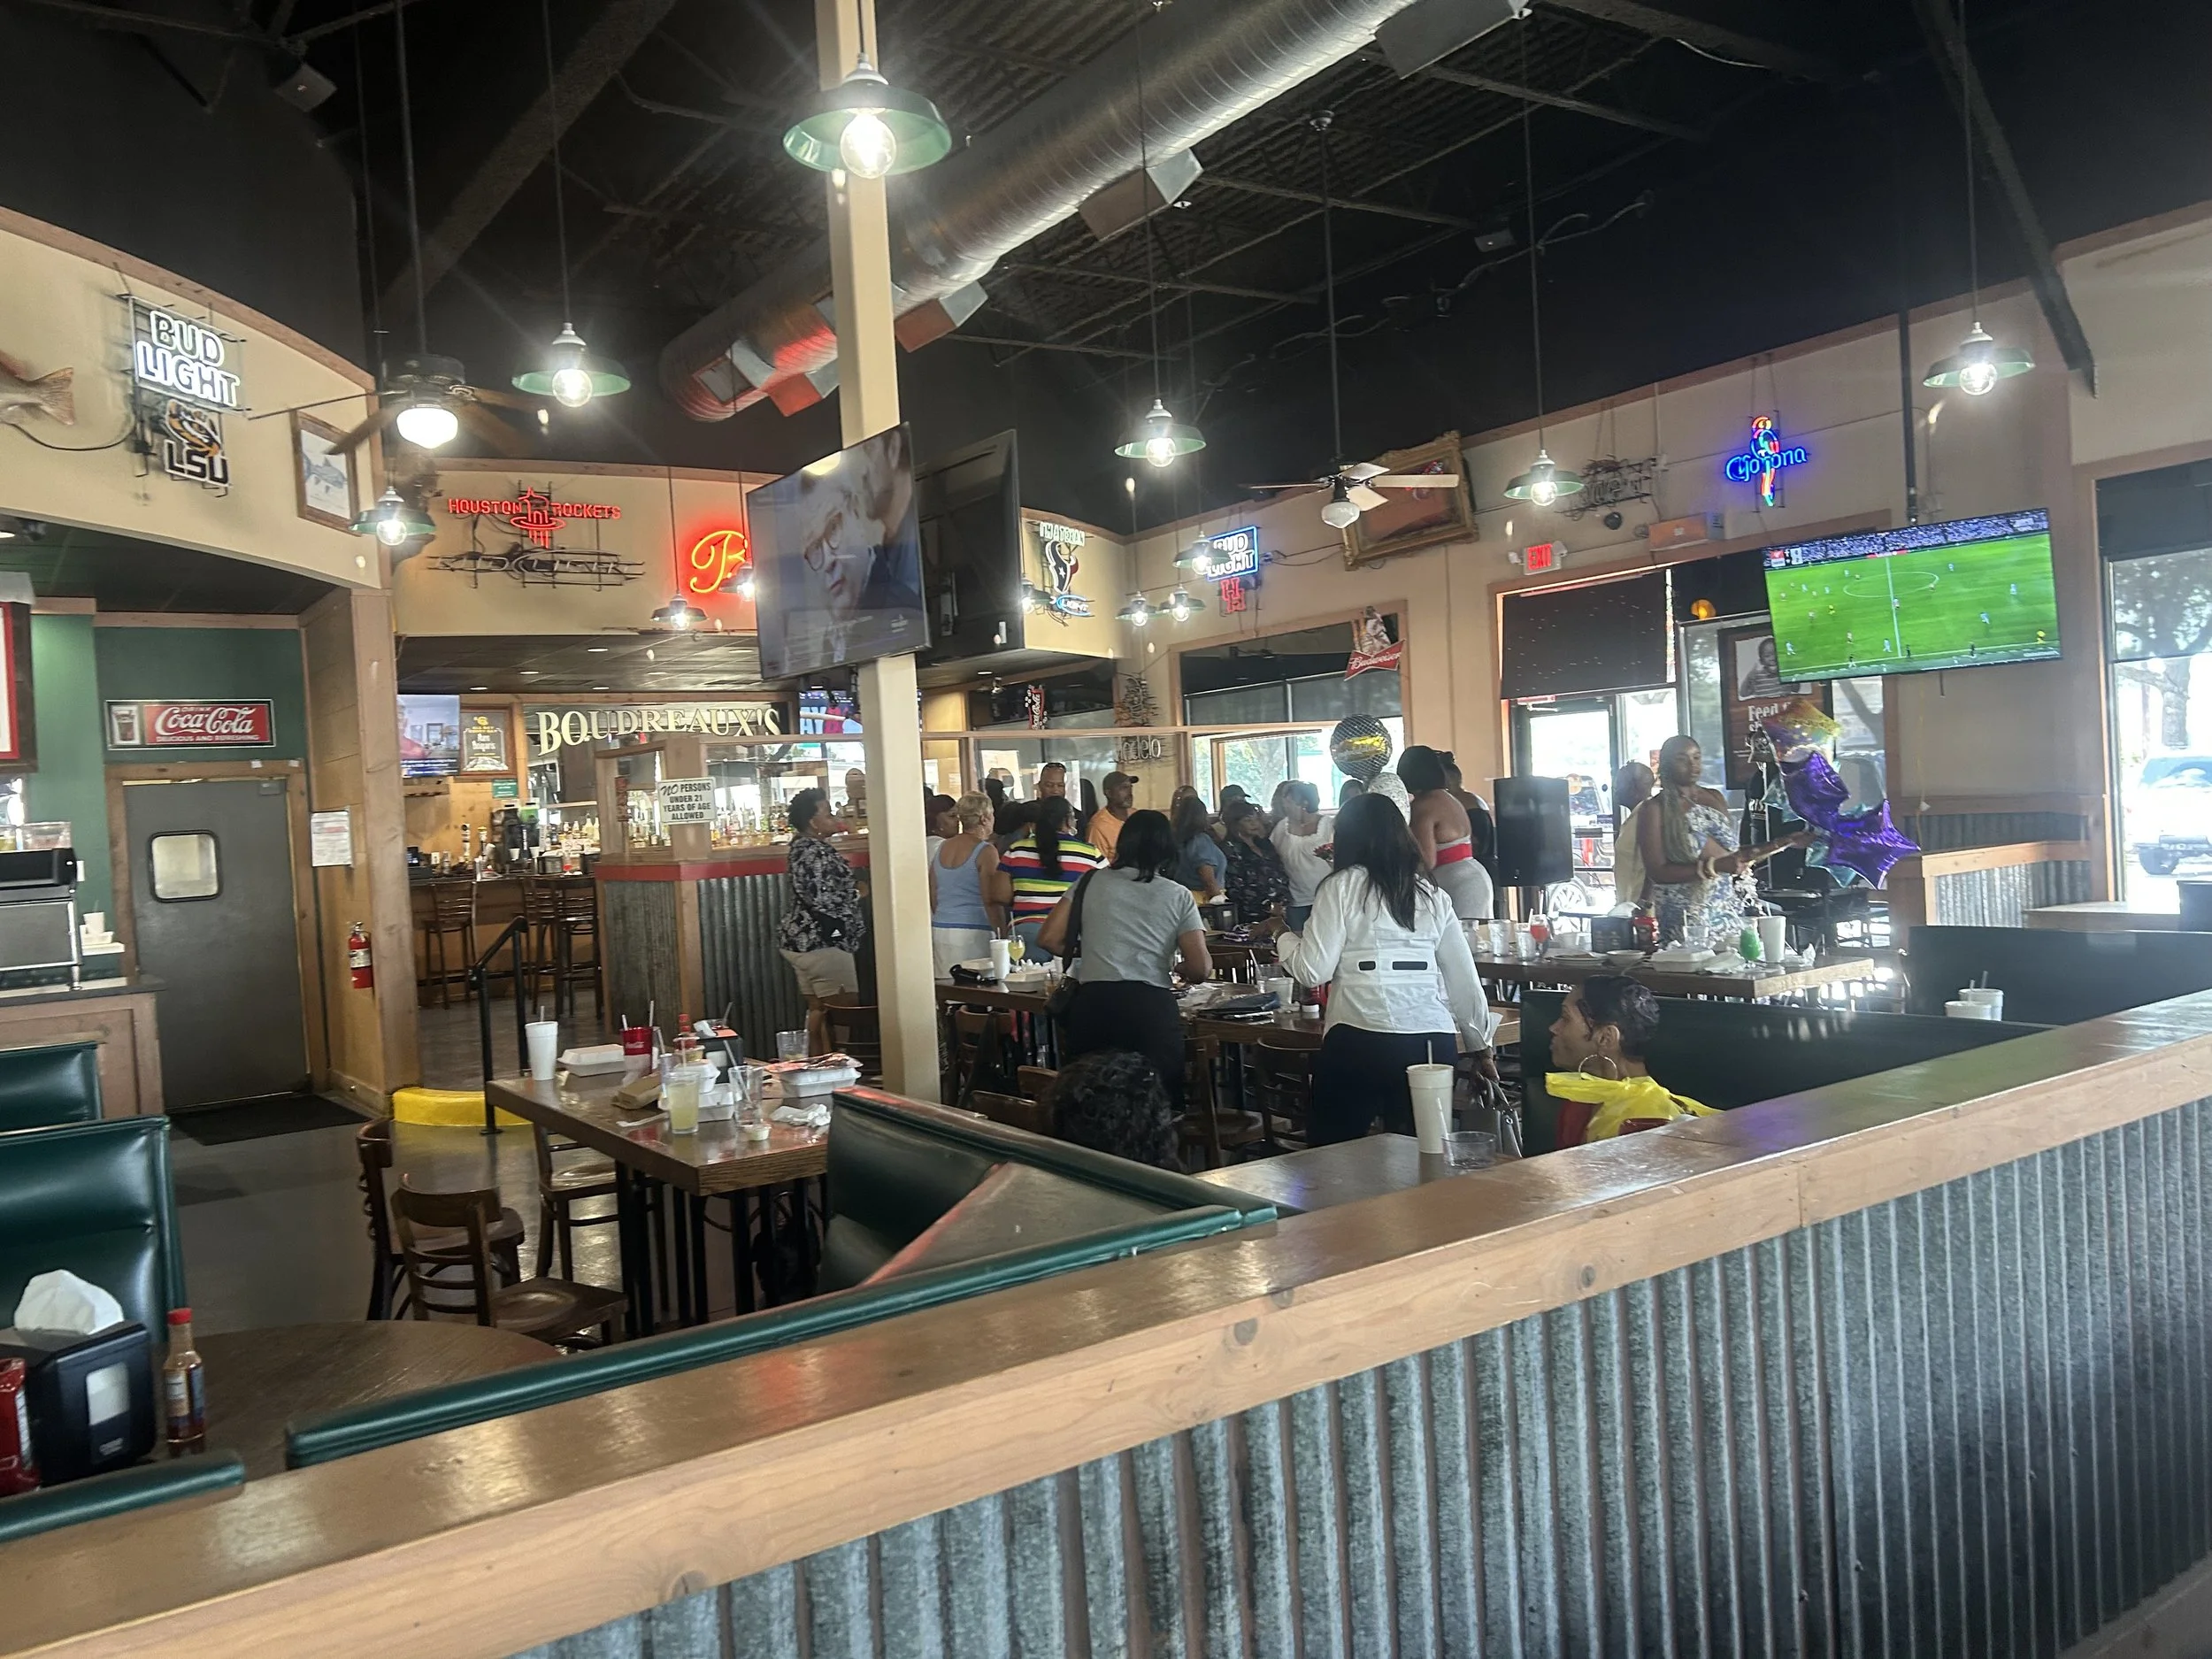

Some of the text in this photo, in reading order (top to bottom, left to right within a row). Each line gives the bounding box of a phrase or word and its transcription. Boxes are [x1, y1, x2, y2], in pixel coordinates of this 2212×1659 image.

[150, 311, 225, 367] BUD
[136, 341, 241, 407] LIGHT
[164, 439, 231, 487] LSU
[1726, 448, 1807, 482] Corona
[448, 499, 622, 520] HOUSTON ROCKETS
[1528, 543, 1553, 570] EXIT
[1348, 652, 1402, 670] Budweiser
[155, 707, 257, 735] Coca-Cola
[535, 708, 781, 757] BOUDREAUX'S
[660, 783, 710, 796] NO PERSONS
[669, 795, 693, 803] UNDER
[664, 803, 686, 812] YEARS
[687, 803, 696, 811] OF
[672, 811, 704, 820] ALLOWED
